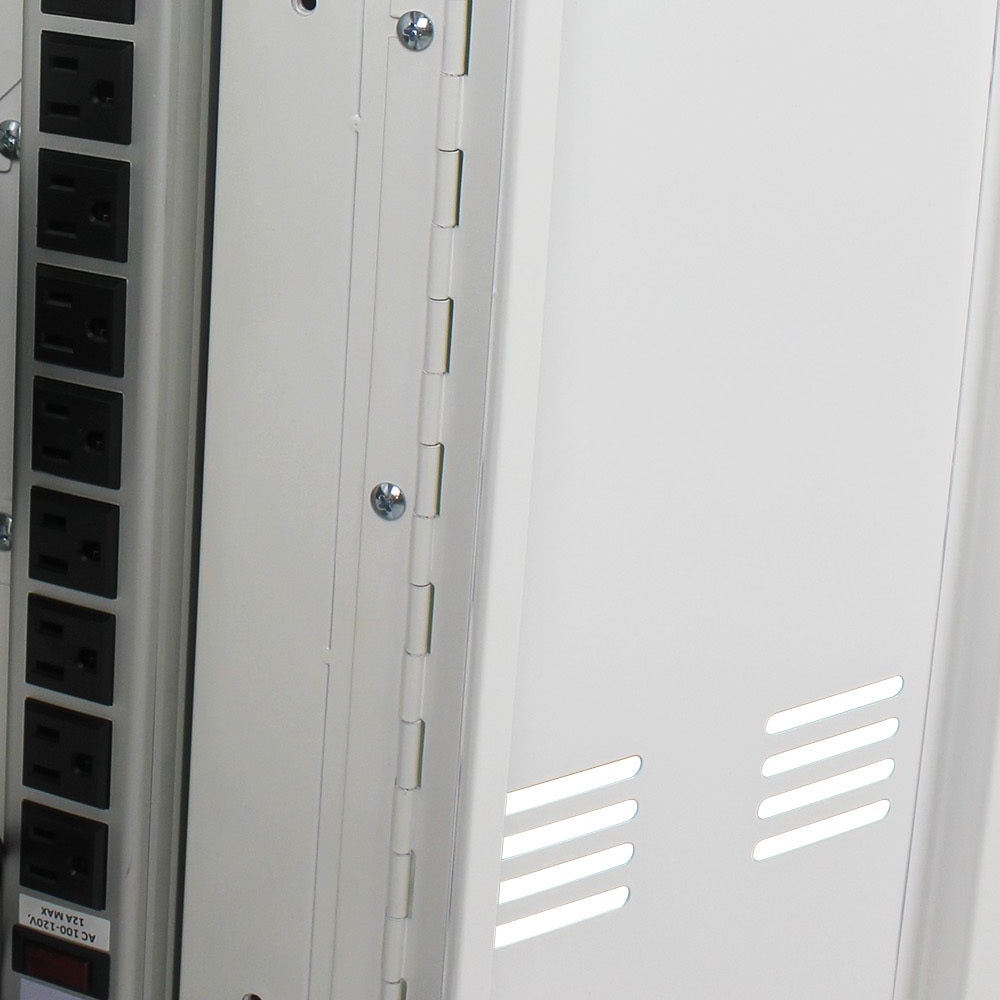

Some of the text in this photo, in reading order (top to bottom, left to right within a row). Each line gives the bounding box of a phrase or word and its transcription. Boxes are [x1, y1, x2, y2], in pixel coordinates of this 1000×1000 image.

[41, 906, 85, 927] 12A MAX
[81, 931, 97, 943] AC
